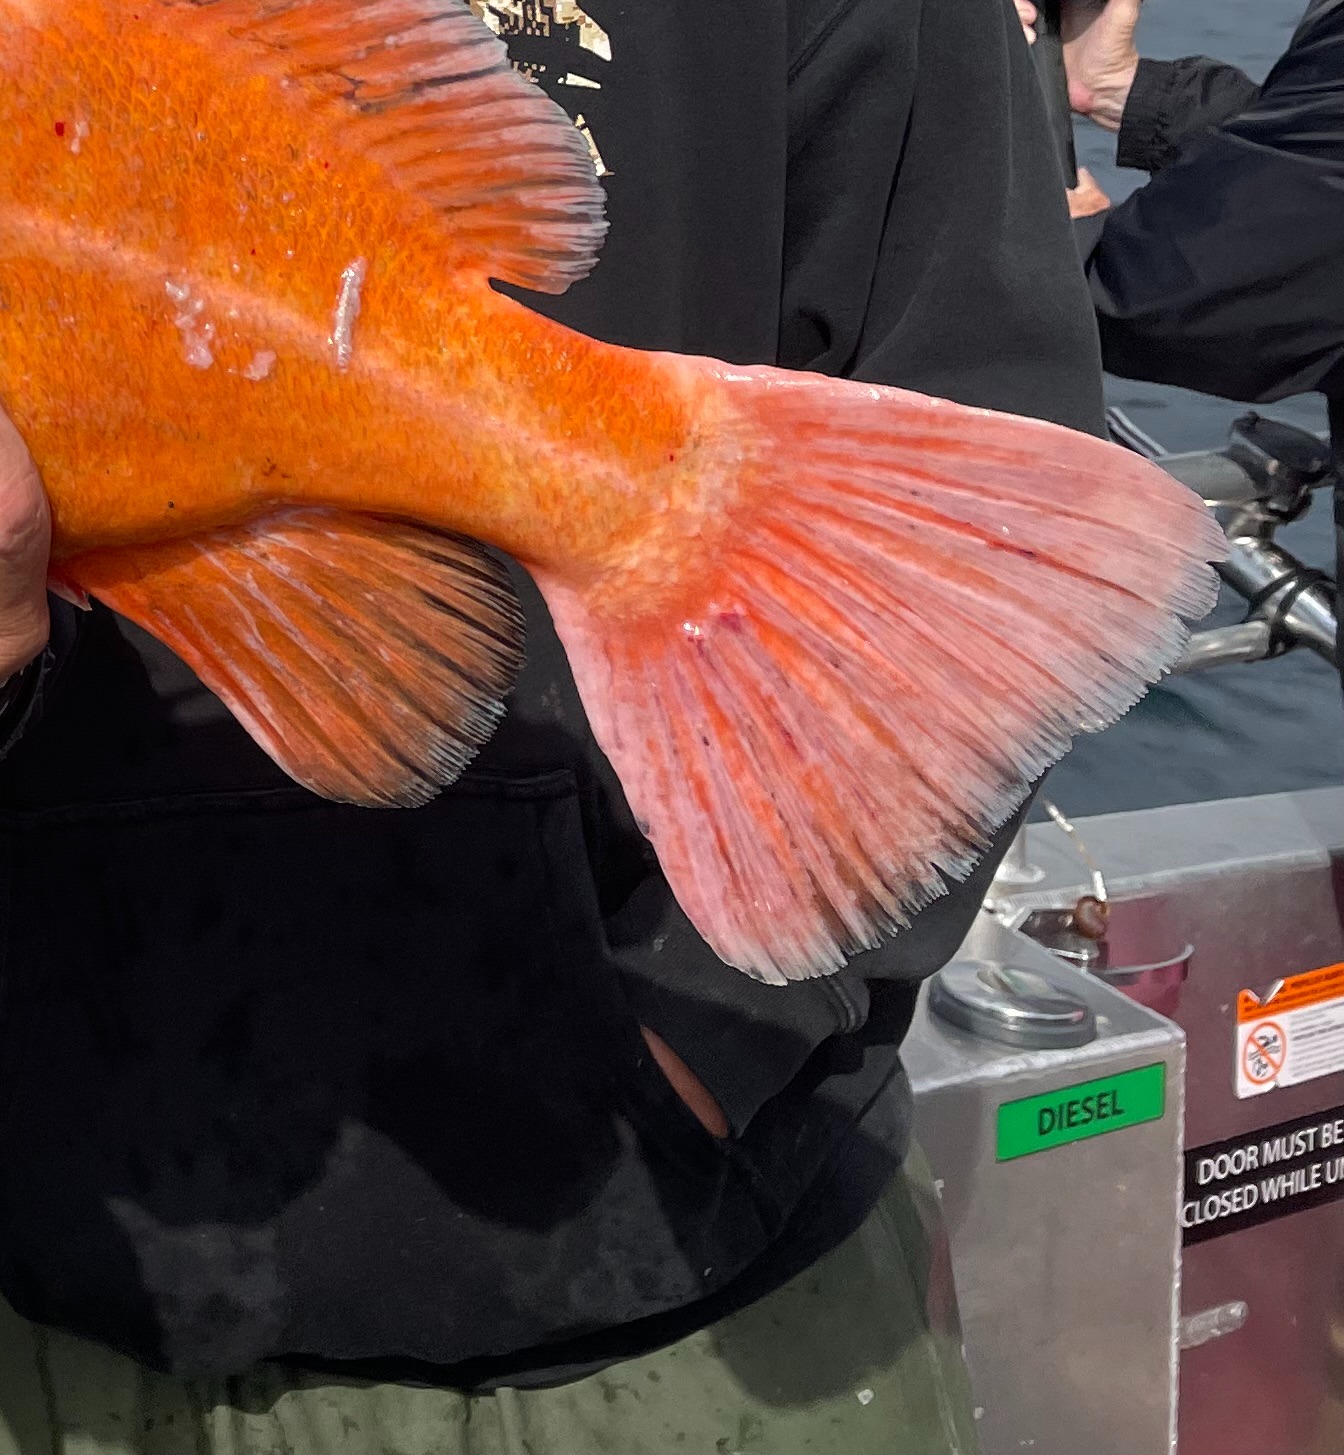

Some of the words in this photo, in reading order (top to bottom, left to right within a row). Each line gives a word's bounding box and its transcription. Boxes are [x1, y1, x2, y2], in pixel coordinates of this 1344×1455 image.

[1038, 1089, 1125, 1136] DIESEL
[1197, 1145, 1259, 1185] DOOR
[1262, 1127, 1318, 1166] MUST
[1320, 1119, 1344, 1149] BE
[1180, 1183, 1259, 1228] CLOSED
[1261, 1163, 1322, 1204] WHILE
